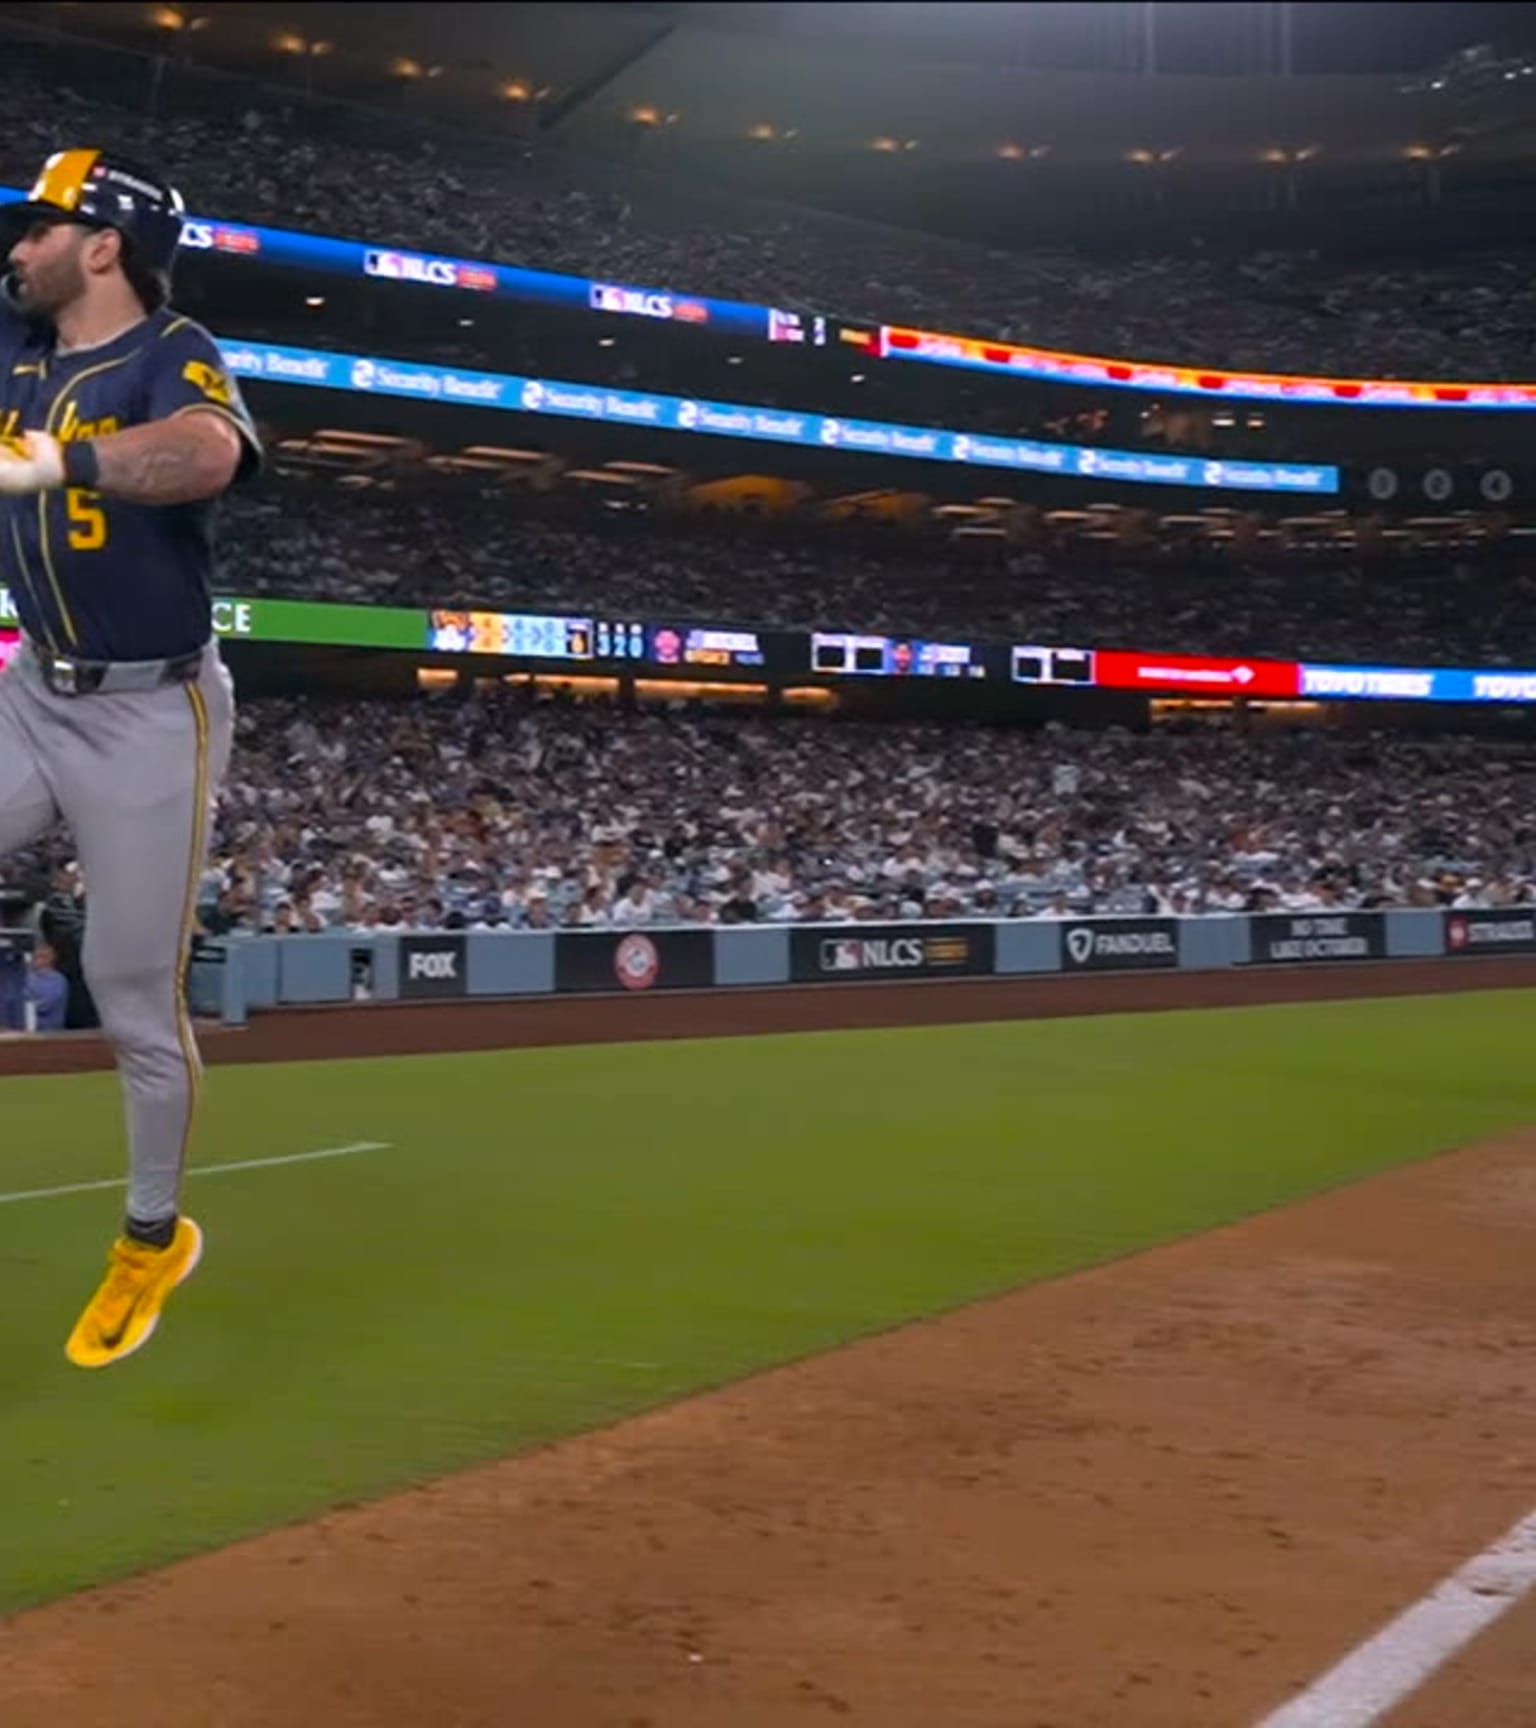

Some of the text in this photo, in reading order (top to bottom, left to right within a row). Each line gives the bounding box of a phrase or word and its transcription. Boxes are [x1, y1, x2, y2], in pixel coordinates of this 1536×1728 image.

[178, 222, 213, 248] CS
[67, 487, 106, 549] 5
[864, 938, 923, 968] NLCS
[1096, 932, 1174, 955] FANDUEL
[409, 951, 457, 979] FOX
